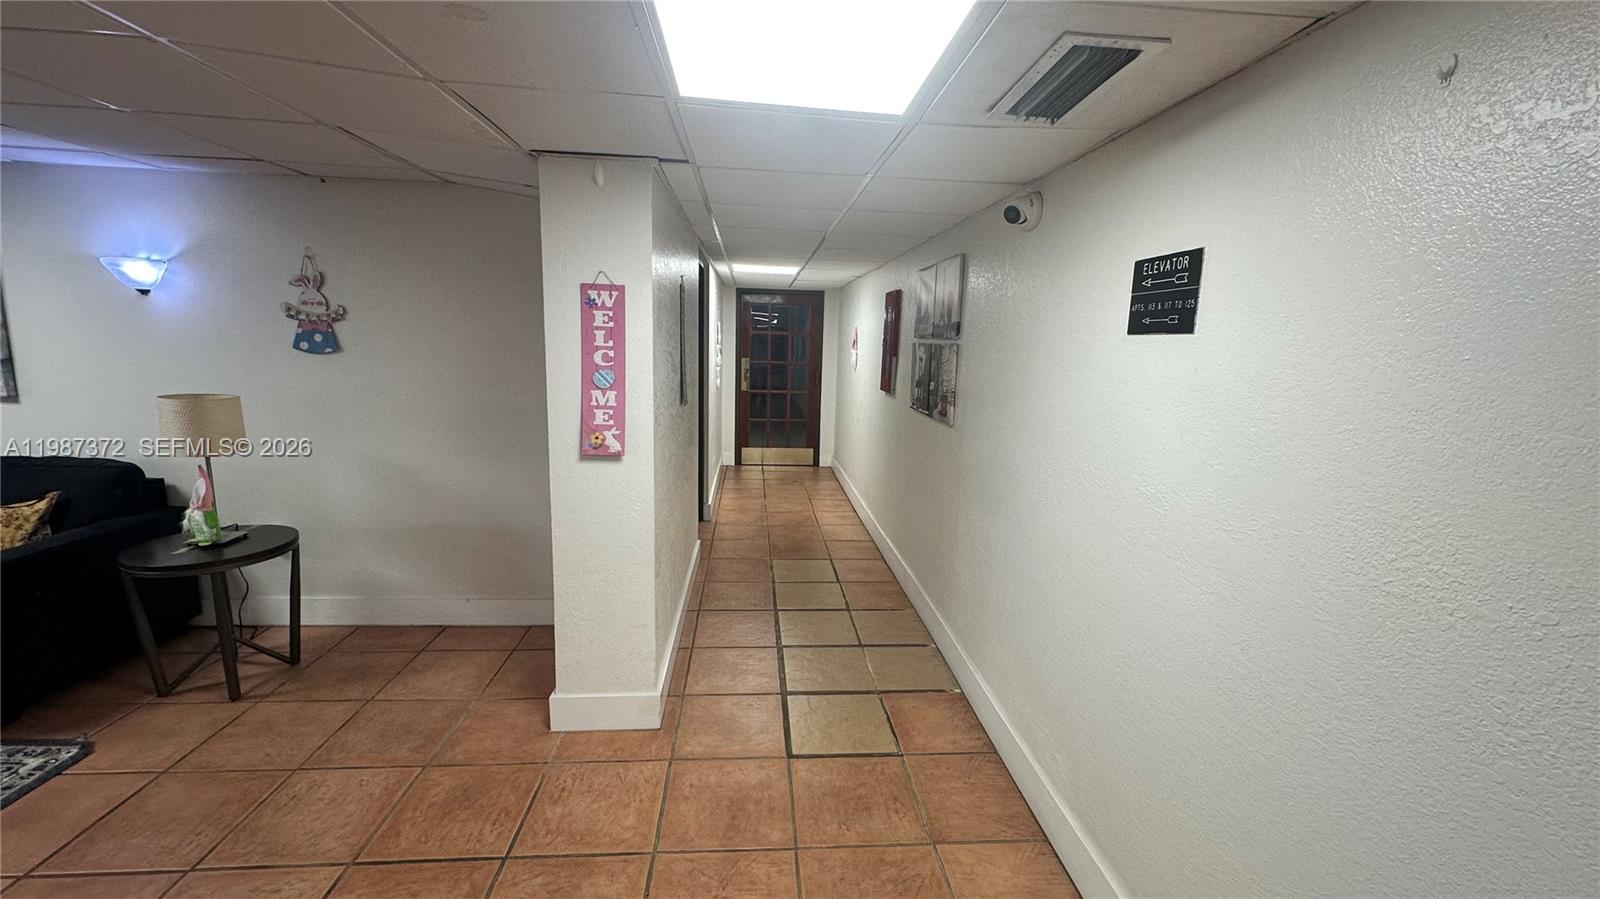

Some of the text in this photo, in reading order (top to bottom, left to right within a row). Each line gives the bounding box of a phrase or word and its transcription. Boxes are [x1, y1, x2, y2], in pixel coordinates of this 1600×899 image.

[1142, 255, 1190, 275] ELEVATOR
[1175, 300, 1183, 309] TO
[1185, 299, 1196, 308] 125
[587, 290, 619, 425] WELCOME
